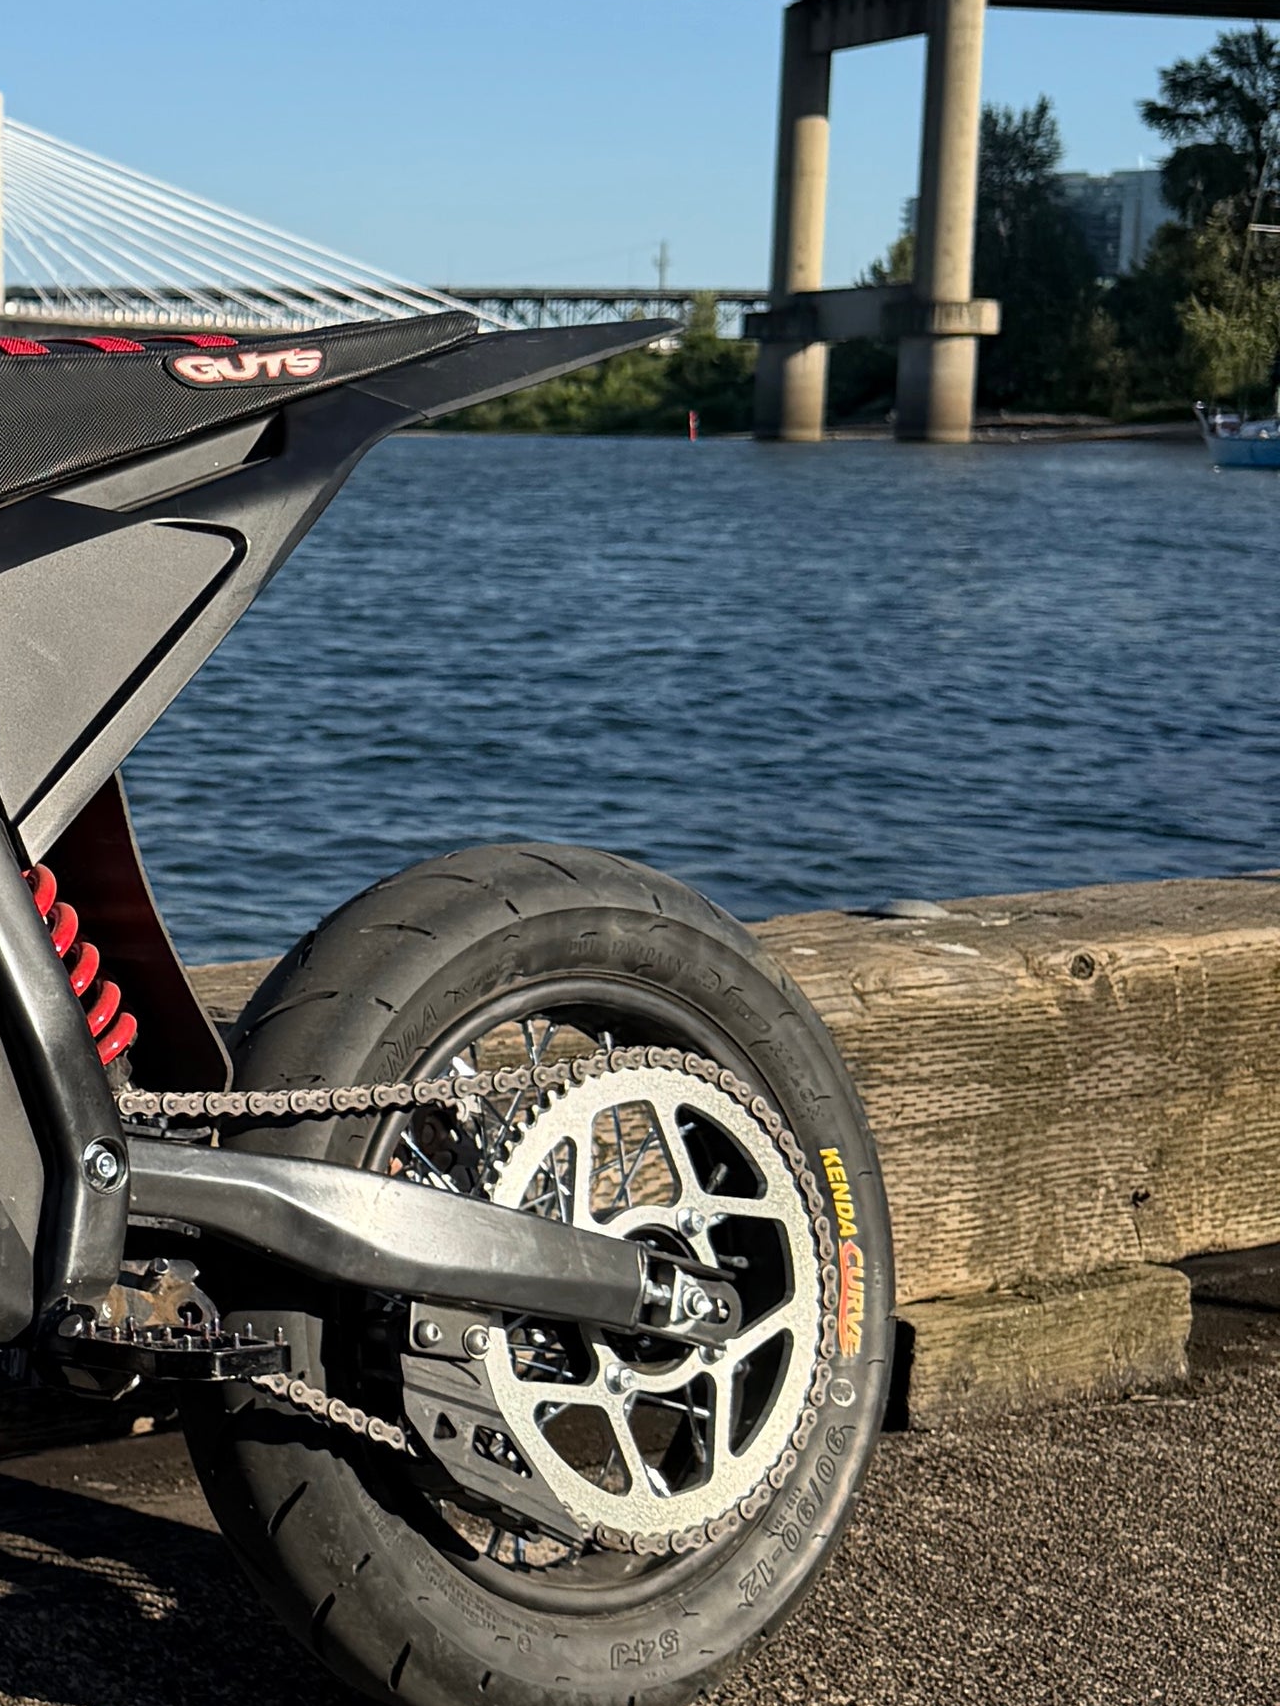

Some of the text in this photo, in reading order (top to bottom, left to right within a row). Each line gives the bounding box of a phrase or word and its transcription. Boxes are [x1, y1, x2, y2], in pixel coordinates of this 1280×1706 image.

[174, 348, 323, 383] GUTS
[820, 1147, 865, 1358] KENDA CURVE
[738, 1425, 849, 1604] 90/90-12
[611, 1629, 680, 1672] 54J
